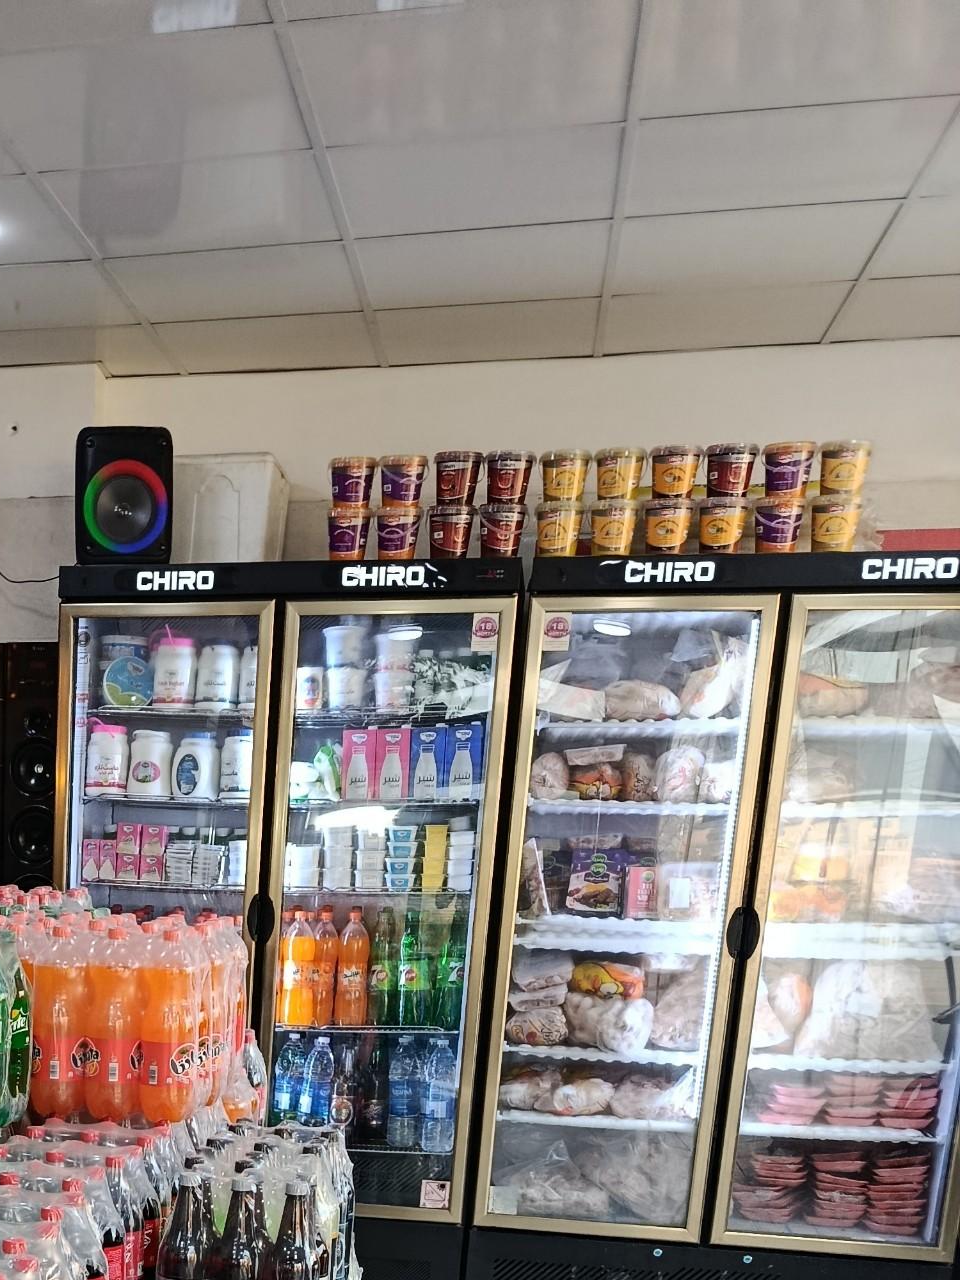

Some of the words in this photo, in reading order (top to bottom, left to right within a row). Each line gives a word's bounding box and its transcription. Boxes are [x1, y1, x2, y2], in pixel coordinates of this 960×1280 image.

[341, 565, 426, 587] CHIRO
[624, 560, 716, 583] CHIRO
[861, 557, 959, 580] CHIRO
[136, 570, 215, 591] CHIRO
